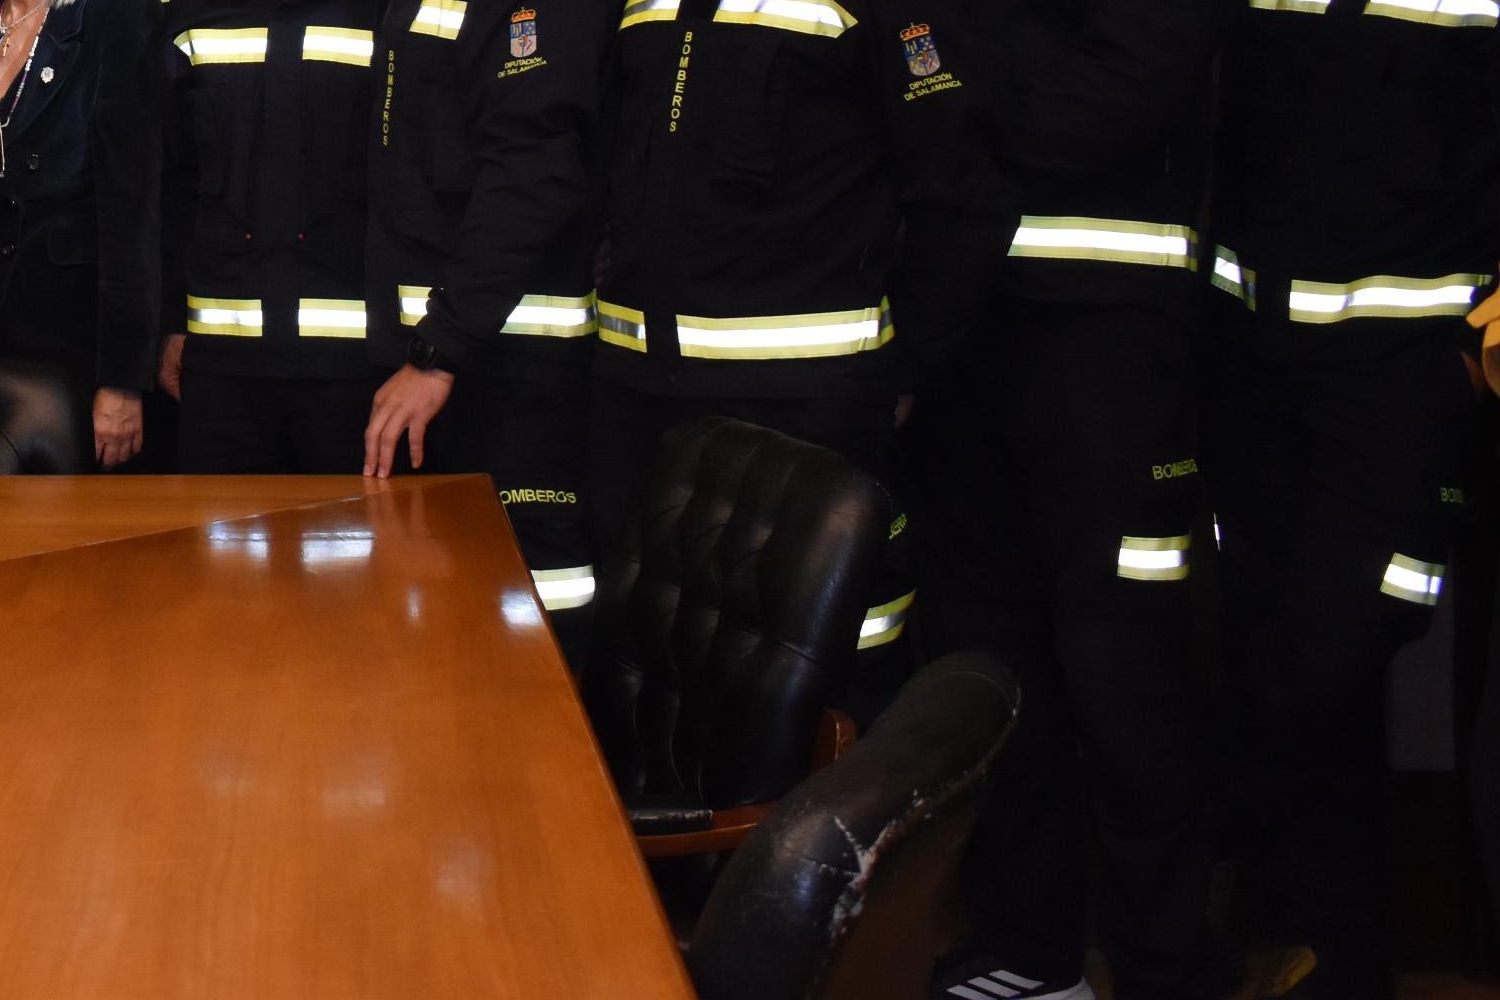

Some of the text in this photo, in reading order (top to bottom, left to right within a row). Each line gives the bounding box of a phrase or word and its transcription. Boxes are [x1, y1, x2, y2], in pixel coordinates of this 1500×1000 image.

[669, 31, 693, 133] BOMBEROS
[903, 81, 962, 101] DE SALAMANCA
[909, 73, 952, 90] DIPUTACIÓN
[382, 50, 395, 146] BOMBEROS
[499, 488, 577, 504] OMBEROS
